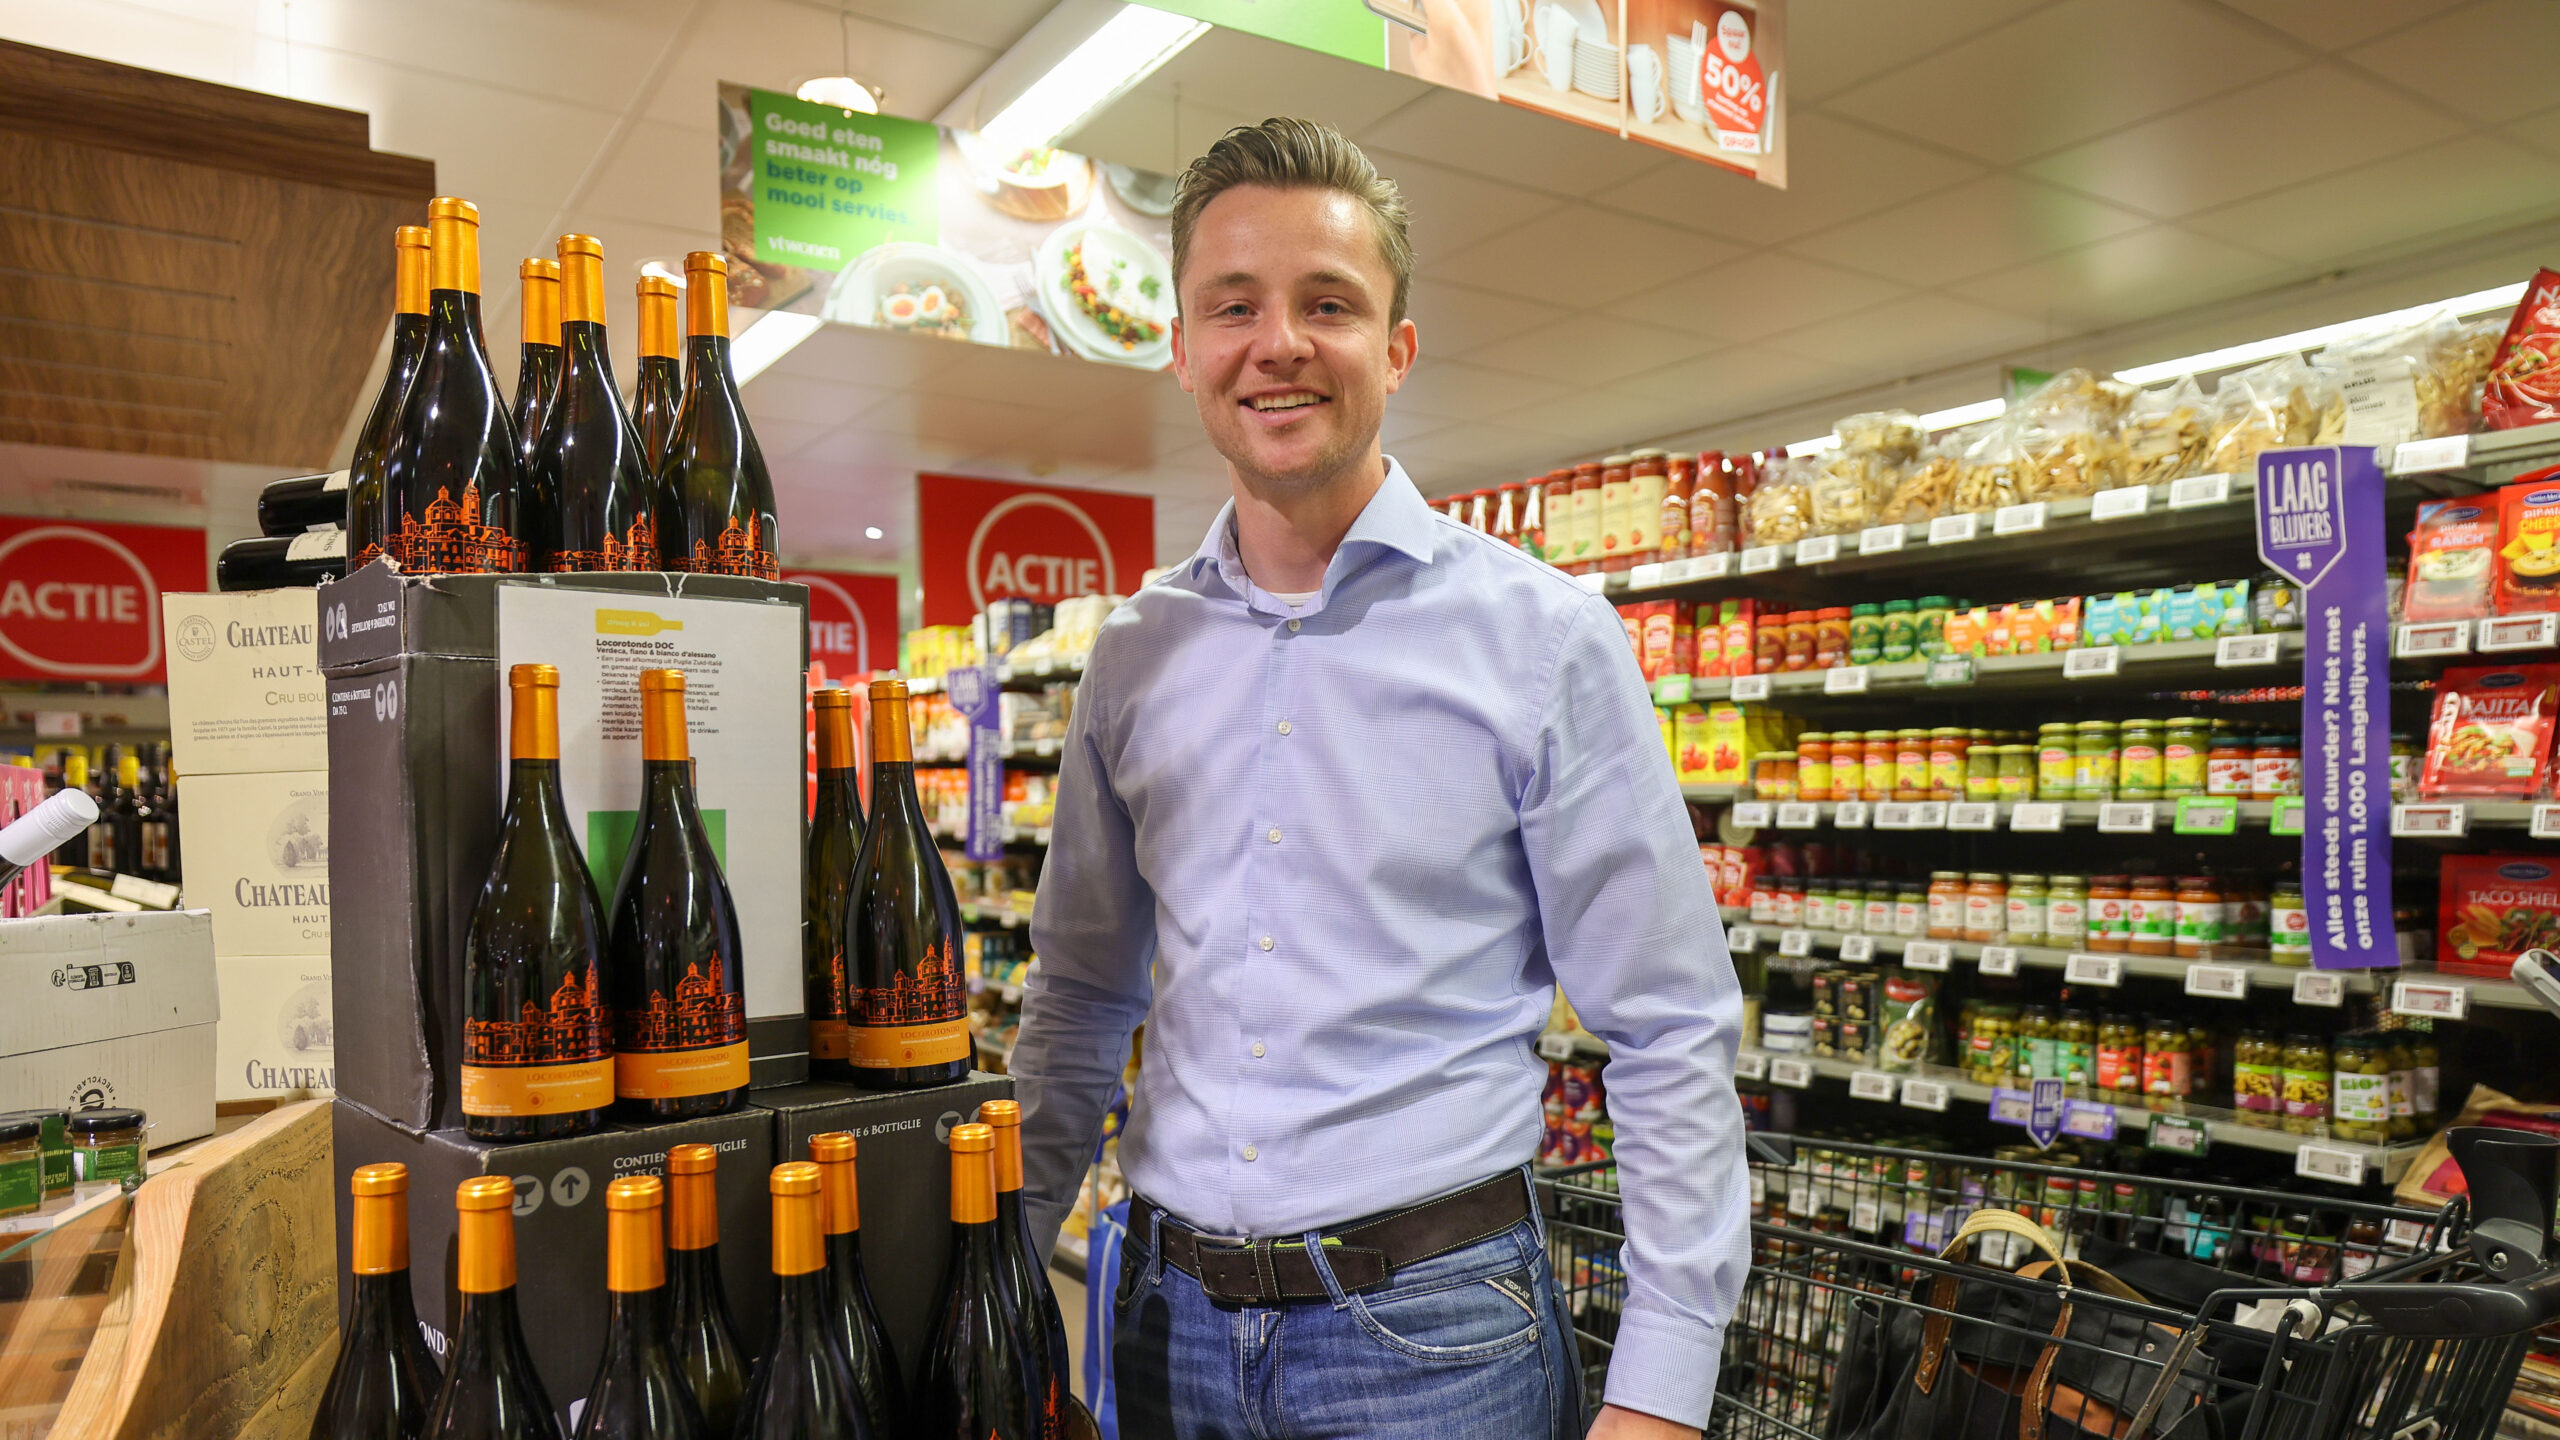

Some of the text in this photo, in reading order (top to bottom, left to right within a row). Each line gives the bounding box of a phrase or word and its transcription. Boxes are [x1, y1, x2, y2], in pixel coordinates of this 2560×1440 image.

[1704, 52, 1763, 113] 50%
[765, 112, 883, 152] Goed eten
[765, 139, 899, 181] smaakt nóg
[766, 159, 864, 195] beter op
[767, 187, 825, 209] mooi
[2267, 460, 2328, 515] LAAG
[2430, 533, 2485, 548] RANCH
[985, 552, 1099, 596] ACTIE
[0, 580, 139, 623] ACTIE
[227, 620, 312, 648] CHATEAU
[596, 639, 674, 650] Locorotondo DOC
[596, 647, 629, 655] Verdeca,
[681, 651, 717, 659] d'alessano
[632, 657, 663, 665] afkomstig
[265, 691, 295, 706] CRU
[615, 710, 637, 718] kruidig
[2321, 605, 2349, 952] Alles steeds duurder? Niet met
[2347, 621, 2374, 951] onze ruim 1.000 Laagblijvers.
[235, 877, 331, 909] CHATEAU
[2467, 890, 2515, 905] TACO
[292, 914, 328, 924] HAUT
[302, 929, 323, 940] CRU
[901, 1025, 961, 1039] LOCOROTONDO
[526, 1066, 603, 1083] LOCOROTONDO
[69, 1075, 115, 1103] RECYCLABLE
[863, 1127, 870, 1137] 6
[871, 1118, 922, 1136] BOTTIGLIE
[1503, 1277, 1531, 1301] REPLAY
